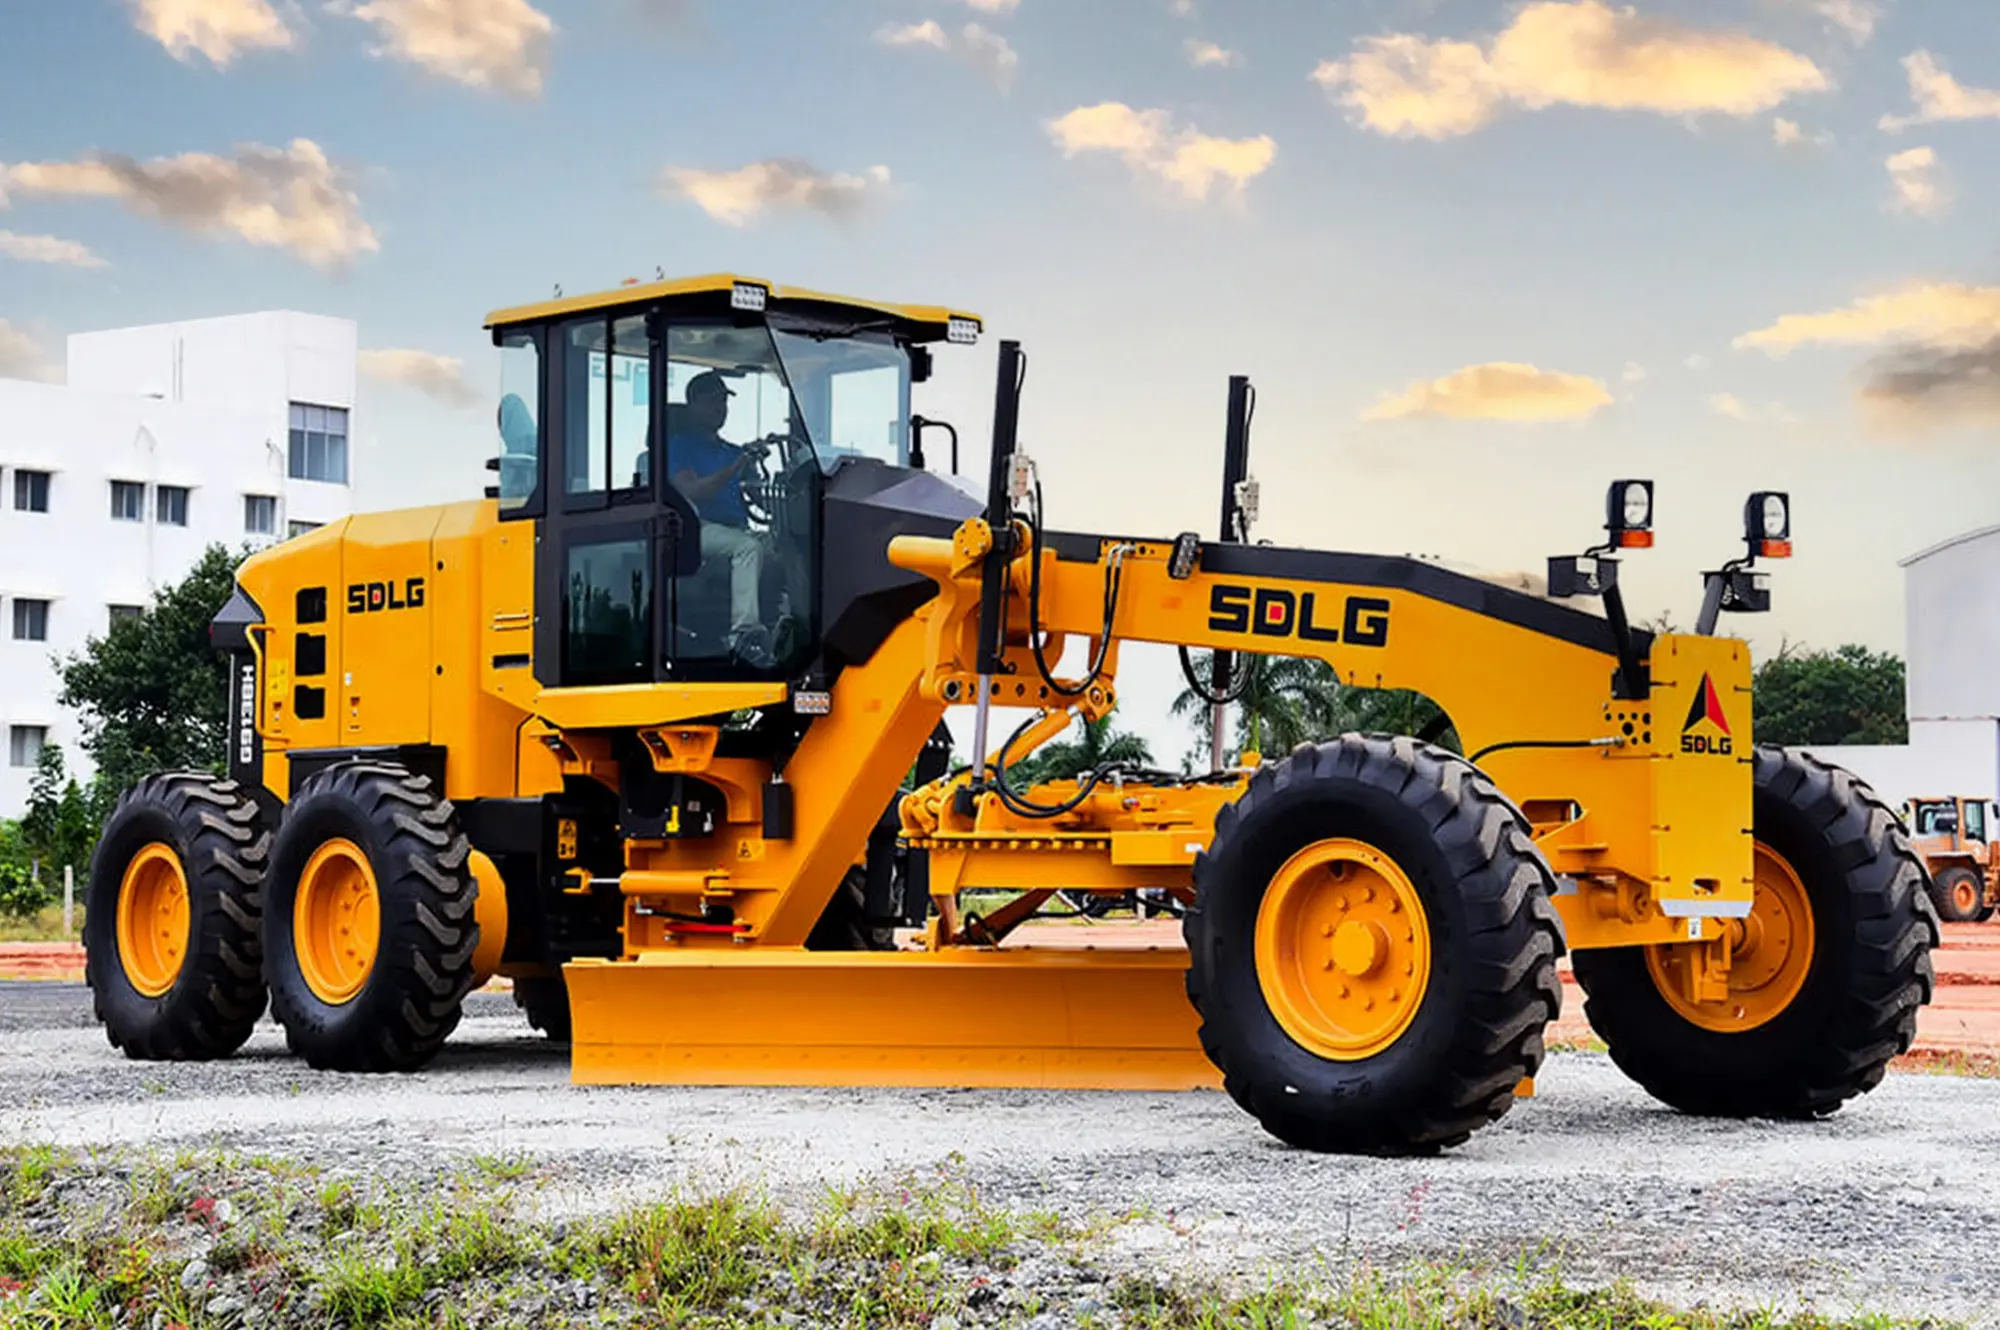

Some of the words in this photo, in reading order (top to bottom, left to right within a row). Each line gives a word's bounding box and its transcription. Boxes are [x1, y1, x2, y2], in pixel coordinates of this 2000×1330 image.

[348, 578, 424, 613] SDLG
[1208, 585, 1390, 647] SDLG
[1681, 735, 1732, 754] SDLG
